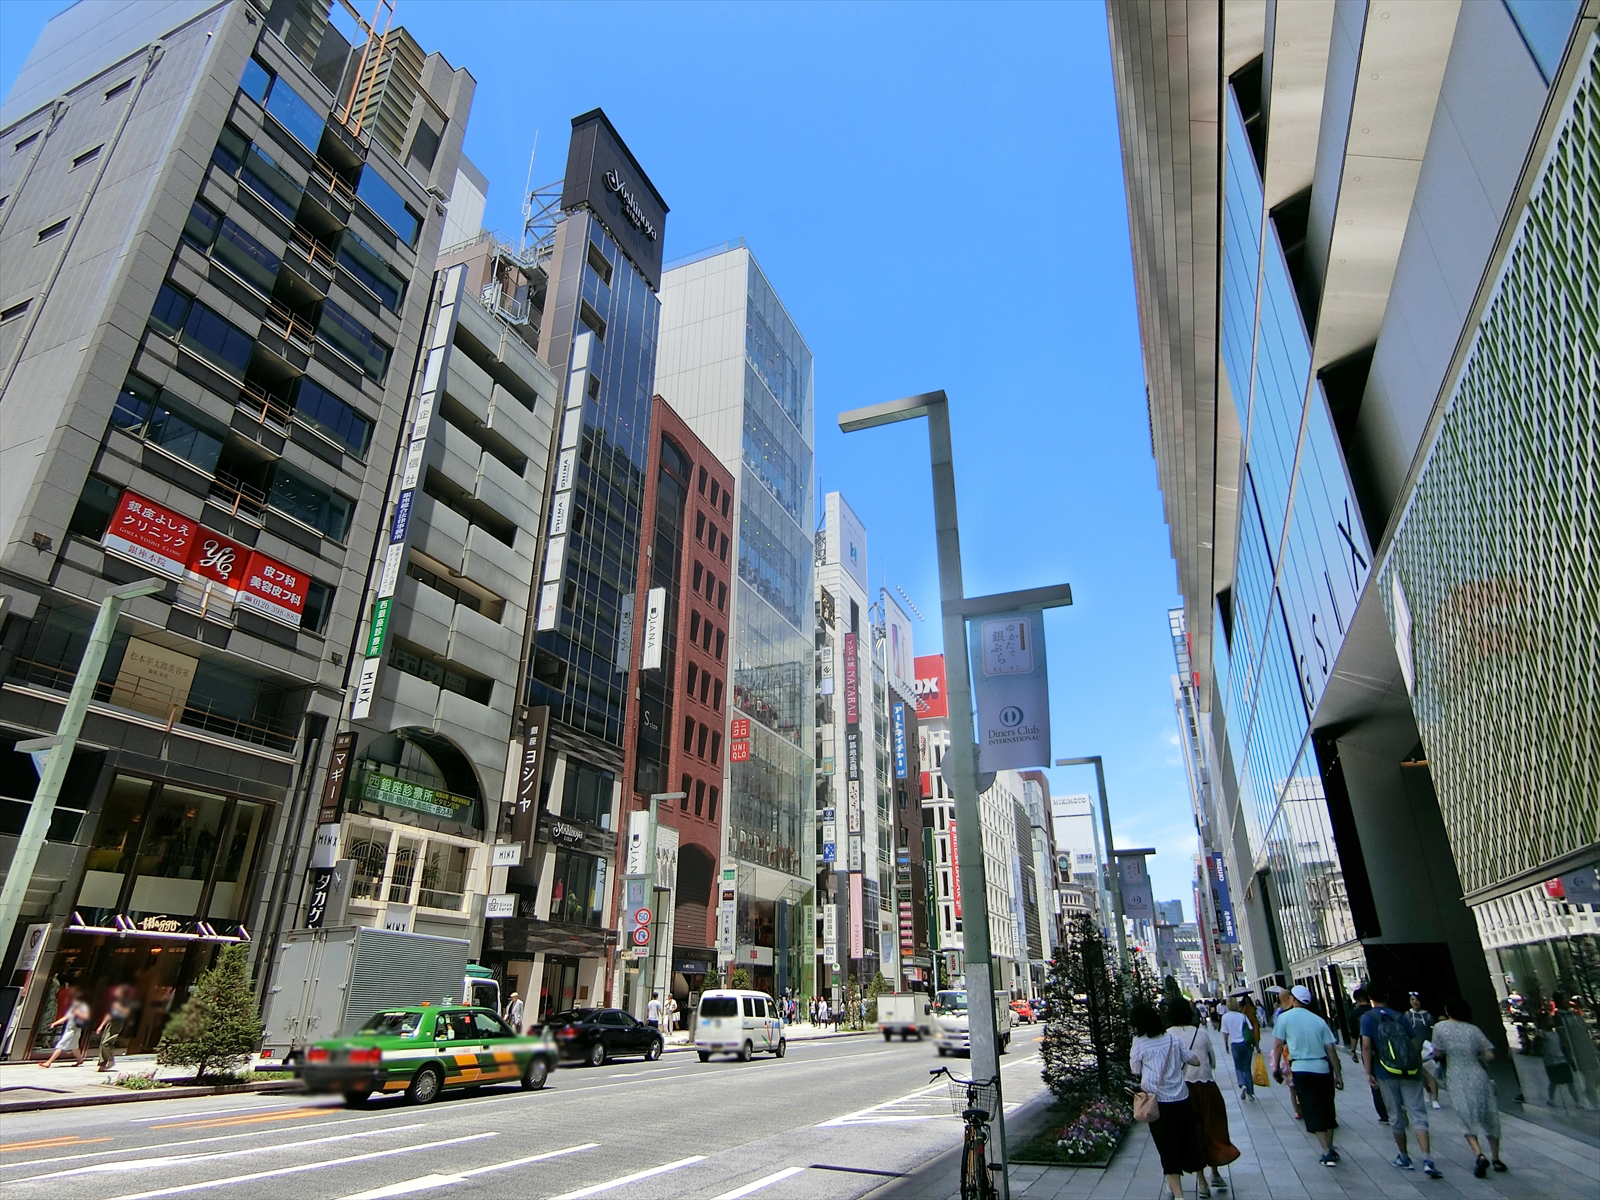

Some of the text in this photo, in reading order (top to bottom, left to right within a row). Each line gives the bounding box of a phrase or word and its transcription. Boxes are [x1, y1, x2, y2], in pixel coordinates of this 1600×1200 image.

[605, 168, 657, 240] Yoshinoya
[560, 458, 568, 488] SHIMA
[123, 515, 186, 547] クリニック
[127, 500, 189, 537] 銀座よしえ
[555, 502, 563, 532] SHIMA
[120, 526, 182, 557] GINZA YOSHIE CLINIC
[250, 576, 301, 606] 美容皮フ科
[264, 566, 296, 588] 皮フ科
[370, 600, 388, 655] 西銀座診療所
[648, 607, 658, 648] DIANA
[1005, 624, 1018, 656] ゆかたで
[991, 631, 1006, 664] 銀ぶら
[358, 672, 374, 704] MINX
[848, 672, 856, 716] NATARAJ
[988, 724, 1040, 739] Diners Club
[988, 735, 1040, 745] INTERNATIONAL
[331, 754, 346, 799] マギー
[369, 774, 433, 802] 西銀座診療所
[318, 834, 338, 847] MINX
[499, 850, 515, 859] MINX
[630, 834, 641, 874] DIAN
[1216, 858, 1224, 882] MIZUHO
[638, 913, 648, 921] 50
